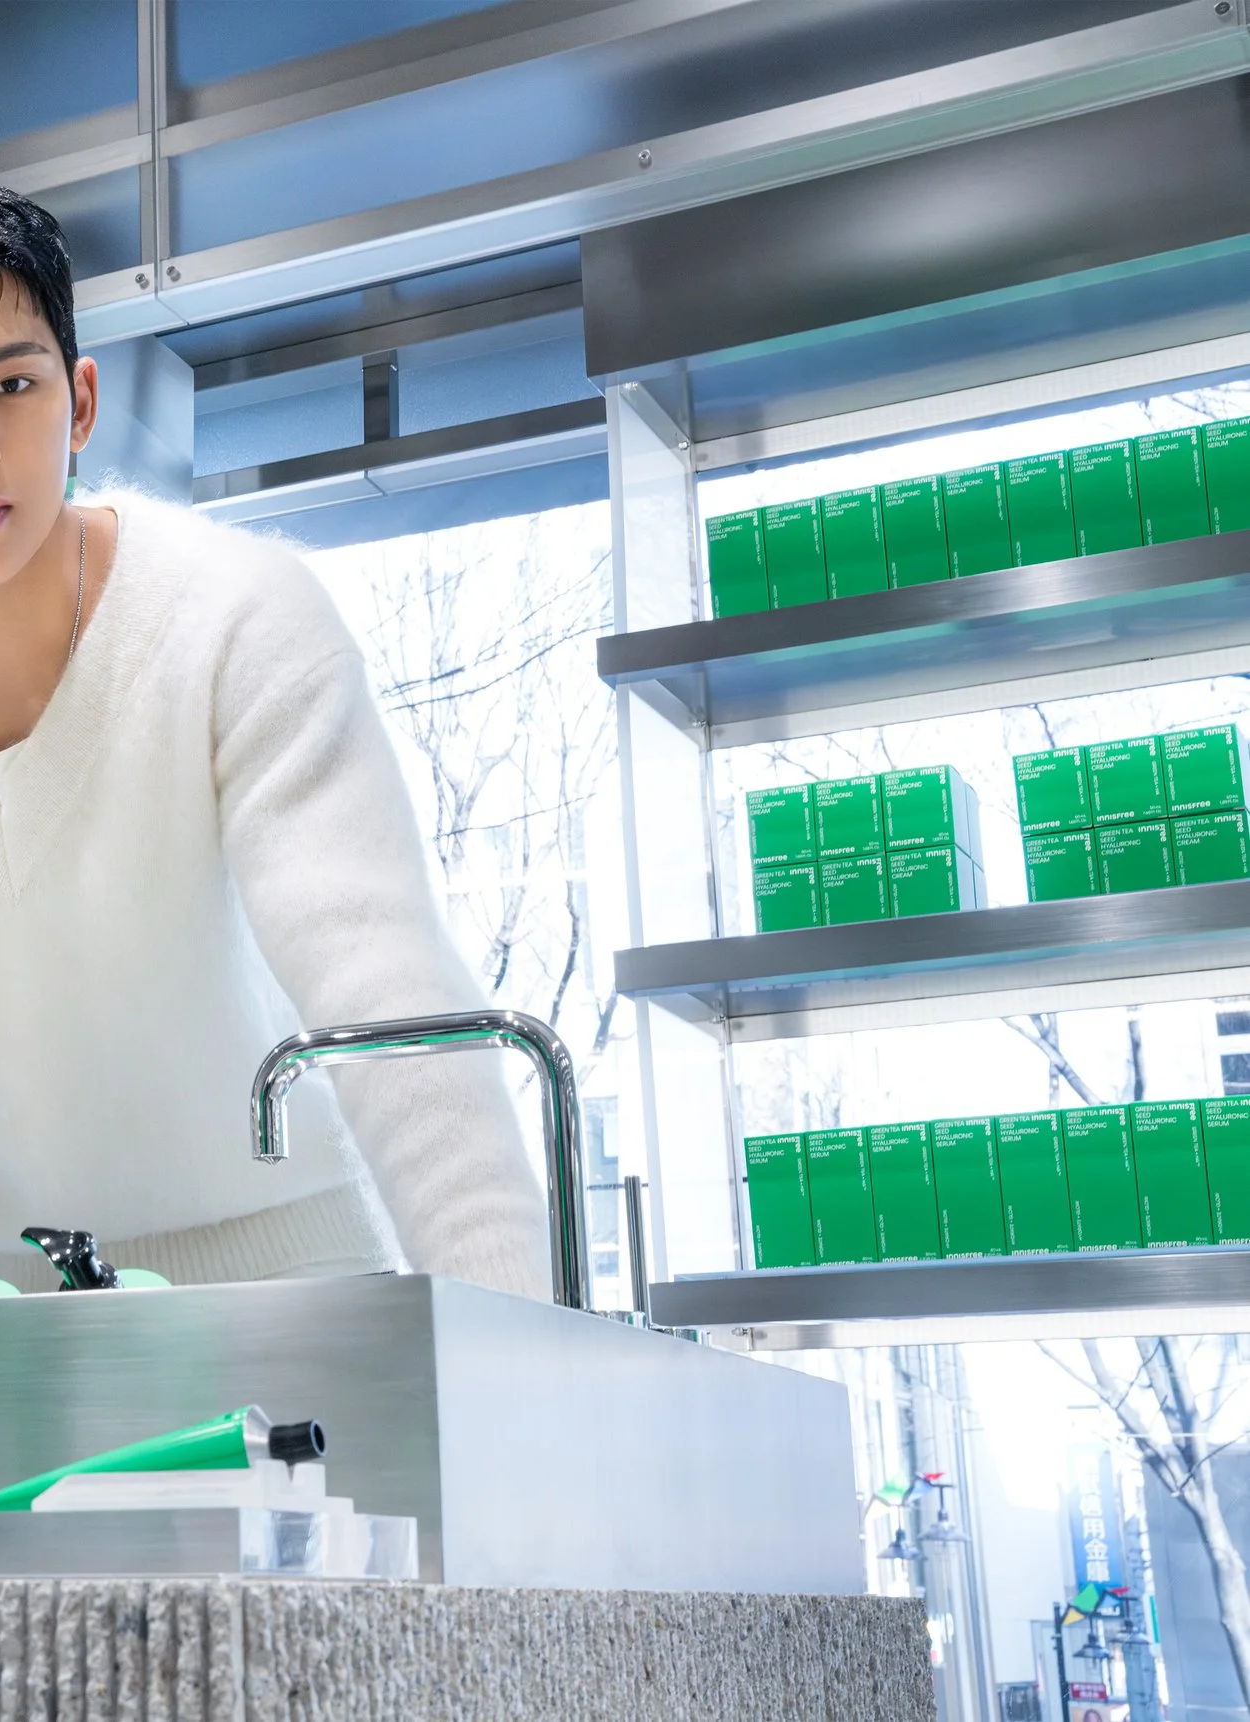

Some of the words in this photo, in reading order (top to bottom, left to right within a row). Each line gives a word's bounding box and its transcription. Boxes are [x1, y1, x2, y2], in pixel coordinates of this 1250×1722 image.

[1205, 422, 1225, 431] GREEN
[1206, 429, 1221, 437] SEED
[1206, 430, 1247, 442] HYALURONIC
[1138, 434, 1158, 443] GREEN
[1138, 441, 1154, 449] SEED
[1207, 439, 1228, 448] SERUM
[1072, 447, 1091, 455] GREEN
[1139, 443, 1179, 455] HYALURONIC
[1140, 452, 1161, 460] SERUM
[1008, 458, 1026, 467] GREEN
[1073, 455, 1111, 467] HYALURONIC
[1073, 464, 1094, 472] SERUM
[1009, 467, 1046, 479] HYALURONIC
[1010, 476, 1029, 484] SERUM
[884, 481, 901, 490] GREEN
[885, 489, 920, 501] HYALURONIC
[885, 498, 904, 506] SERUM
[1163, 733, 1185, 741] GREEN
[1089, 744, 1110, 752] GREEN
[1165, 742, 1206, 753] HYALURONIC
[1015, 754, 1036, 763] GREEN
[1090, 753, 1130, 764] HYALURONIC
[1165, 751, 1189, 759] CREAM
[1017, 763, 1055, 775] HYALURONIC
[1091, 762, 1114, 770] CREAM
[1017, 772, 1040, 780] CREAM
[885, 781, 922, 791] HYALURONIC
[817, 791, 852, 801] HYALURONIC
[1174, 820, 1196, 828] GREEN
[1175, 829, 1217, 840] HYALURONIC
[1176, 838, 1200, 846] CREAM
[1135, 1116, 1177, 1125] HYALURONIC
[1067, 1122, 1107, 1130] HYALURONIC
[1000, 1127, 1039, 1135] HYALURONIC
[809, 1143, 846, 1152] HYALURONIC
